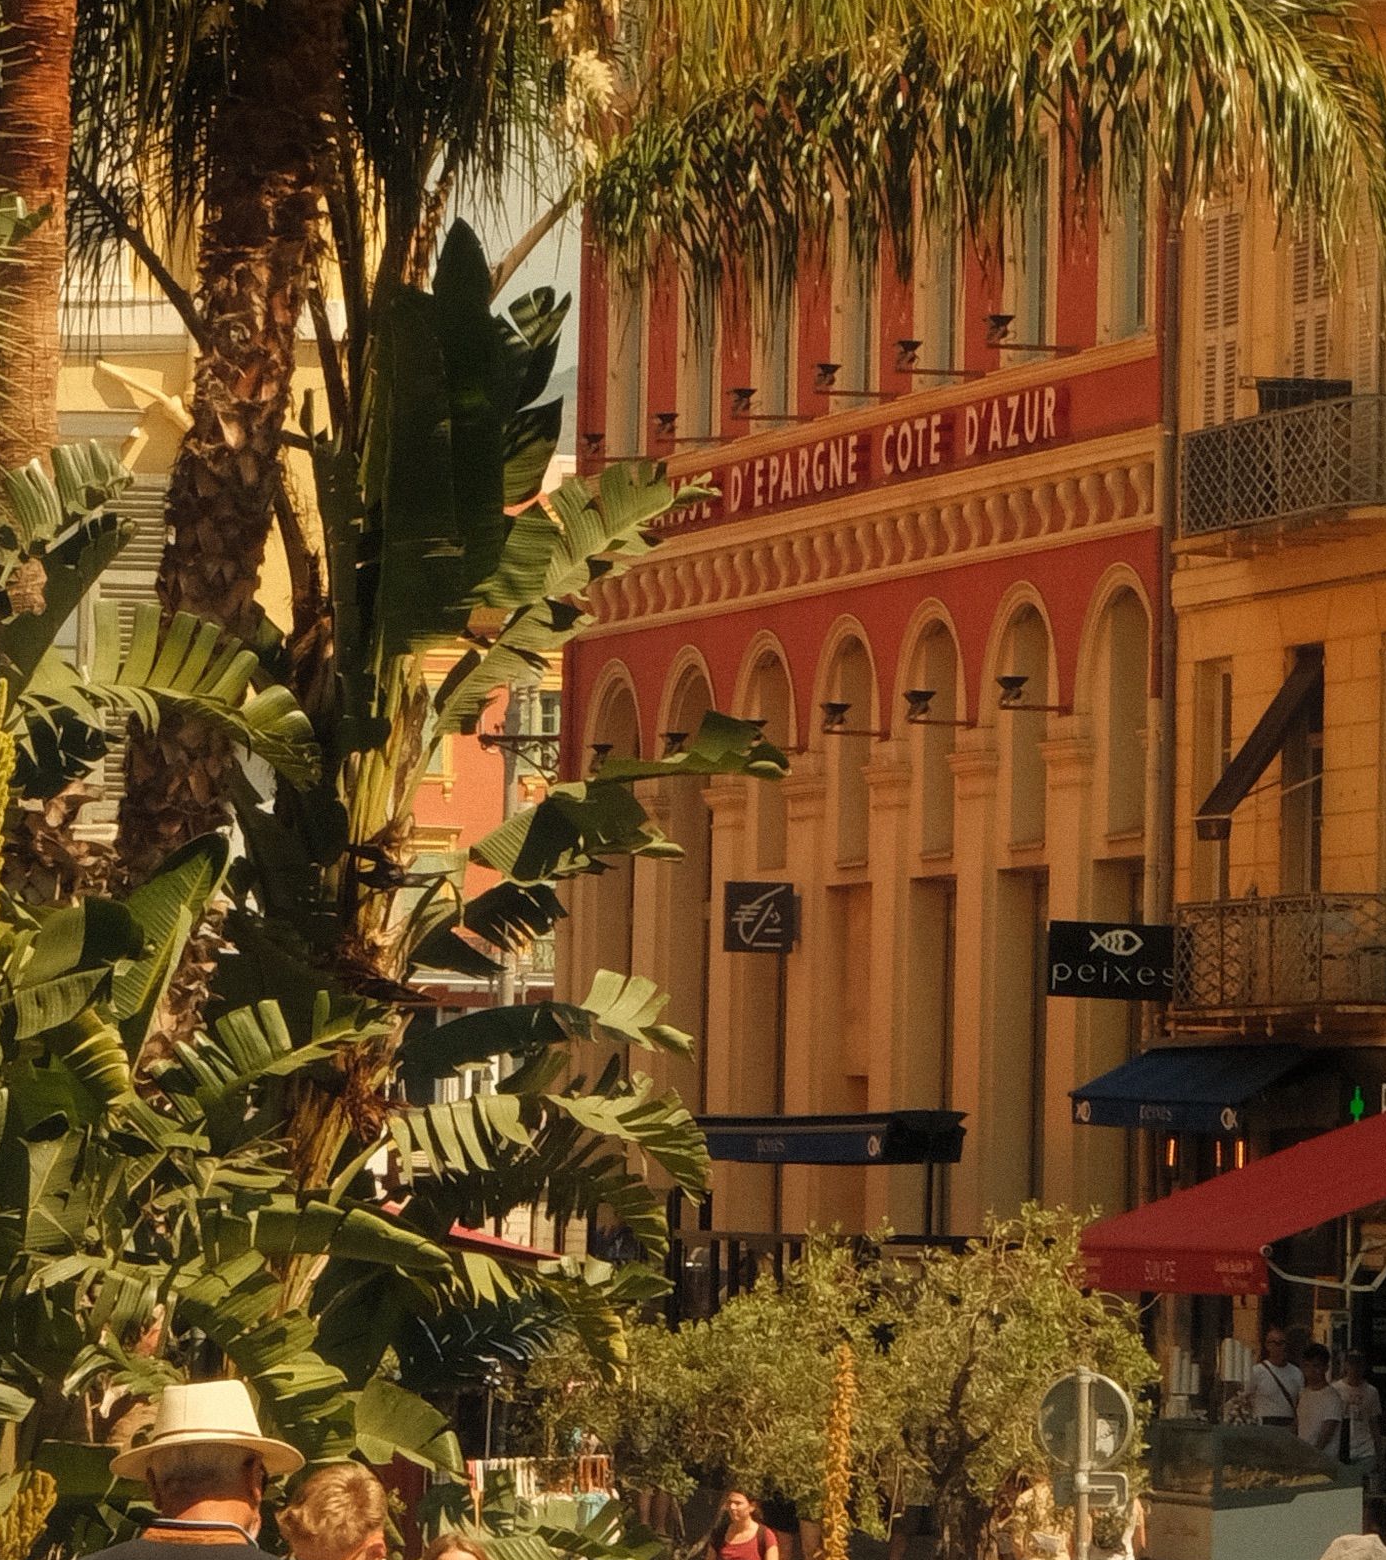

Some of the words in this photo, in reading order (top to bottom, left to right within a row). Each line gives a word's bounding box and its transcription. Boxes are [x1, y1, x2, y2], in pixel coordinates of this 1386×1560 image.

[730, 434, 858, 513] D'EPARGNE
[881, 413, 942, 475] COTE
[965, 386, 1056, 456] D'AZUR
